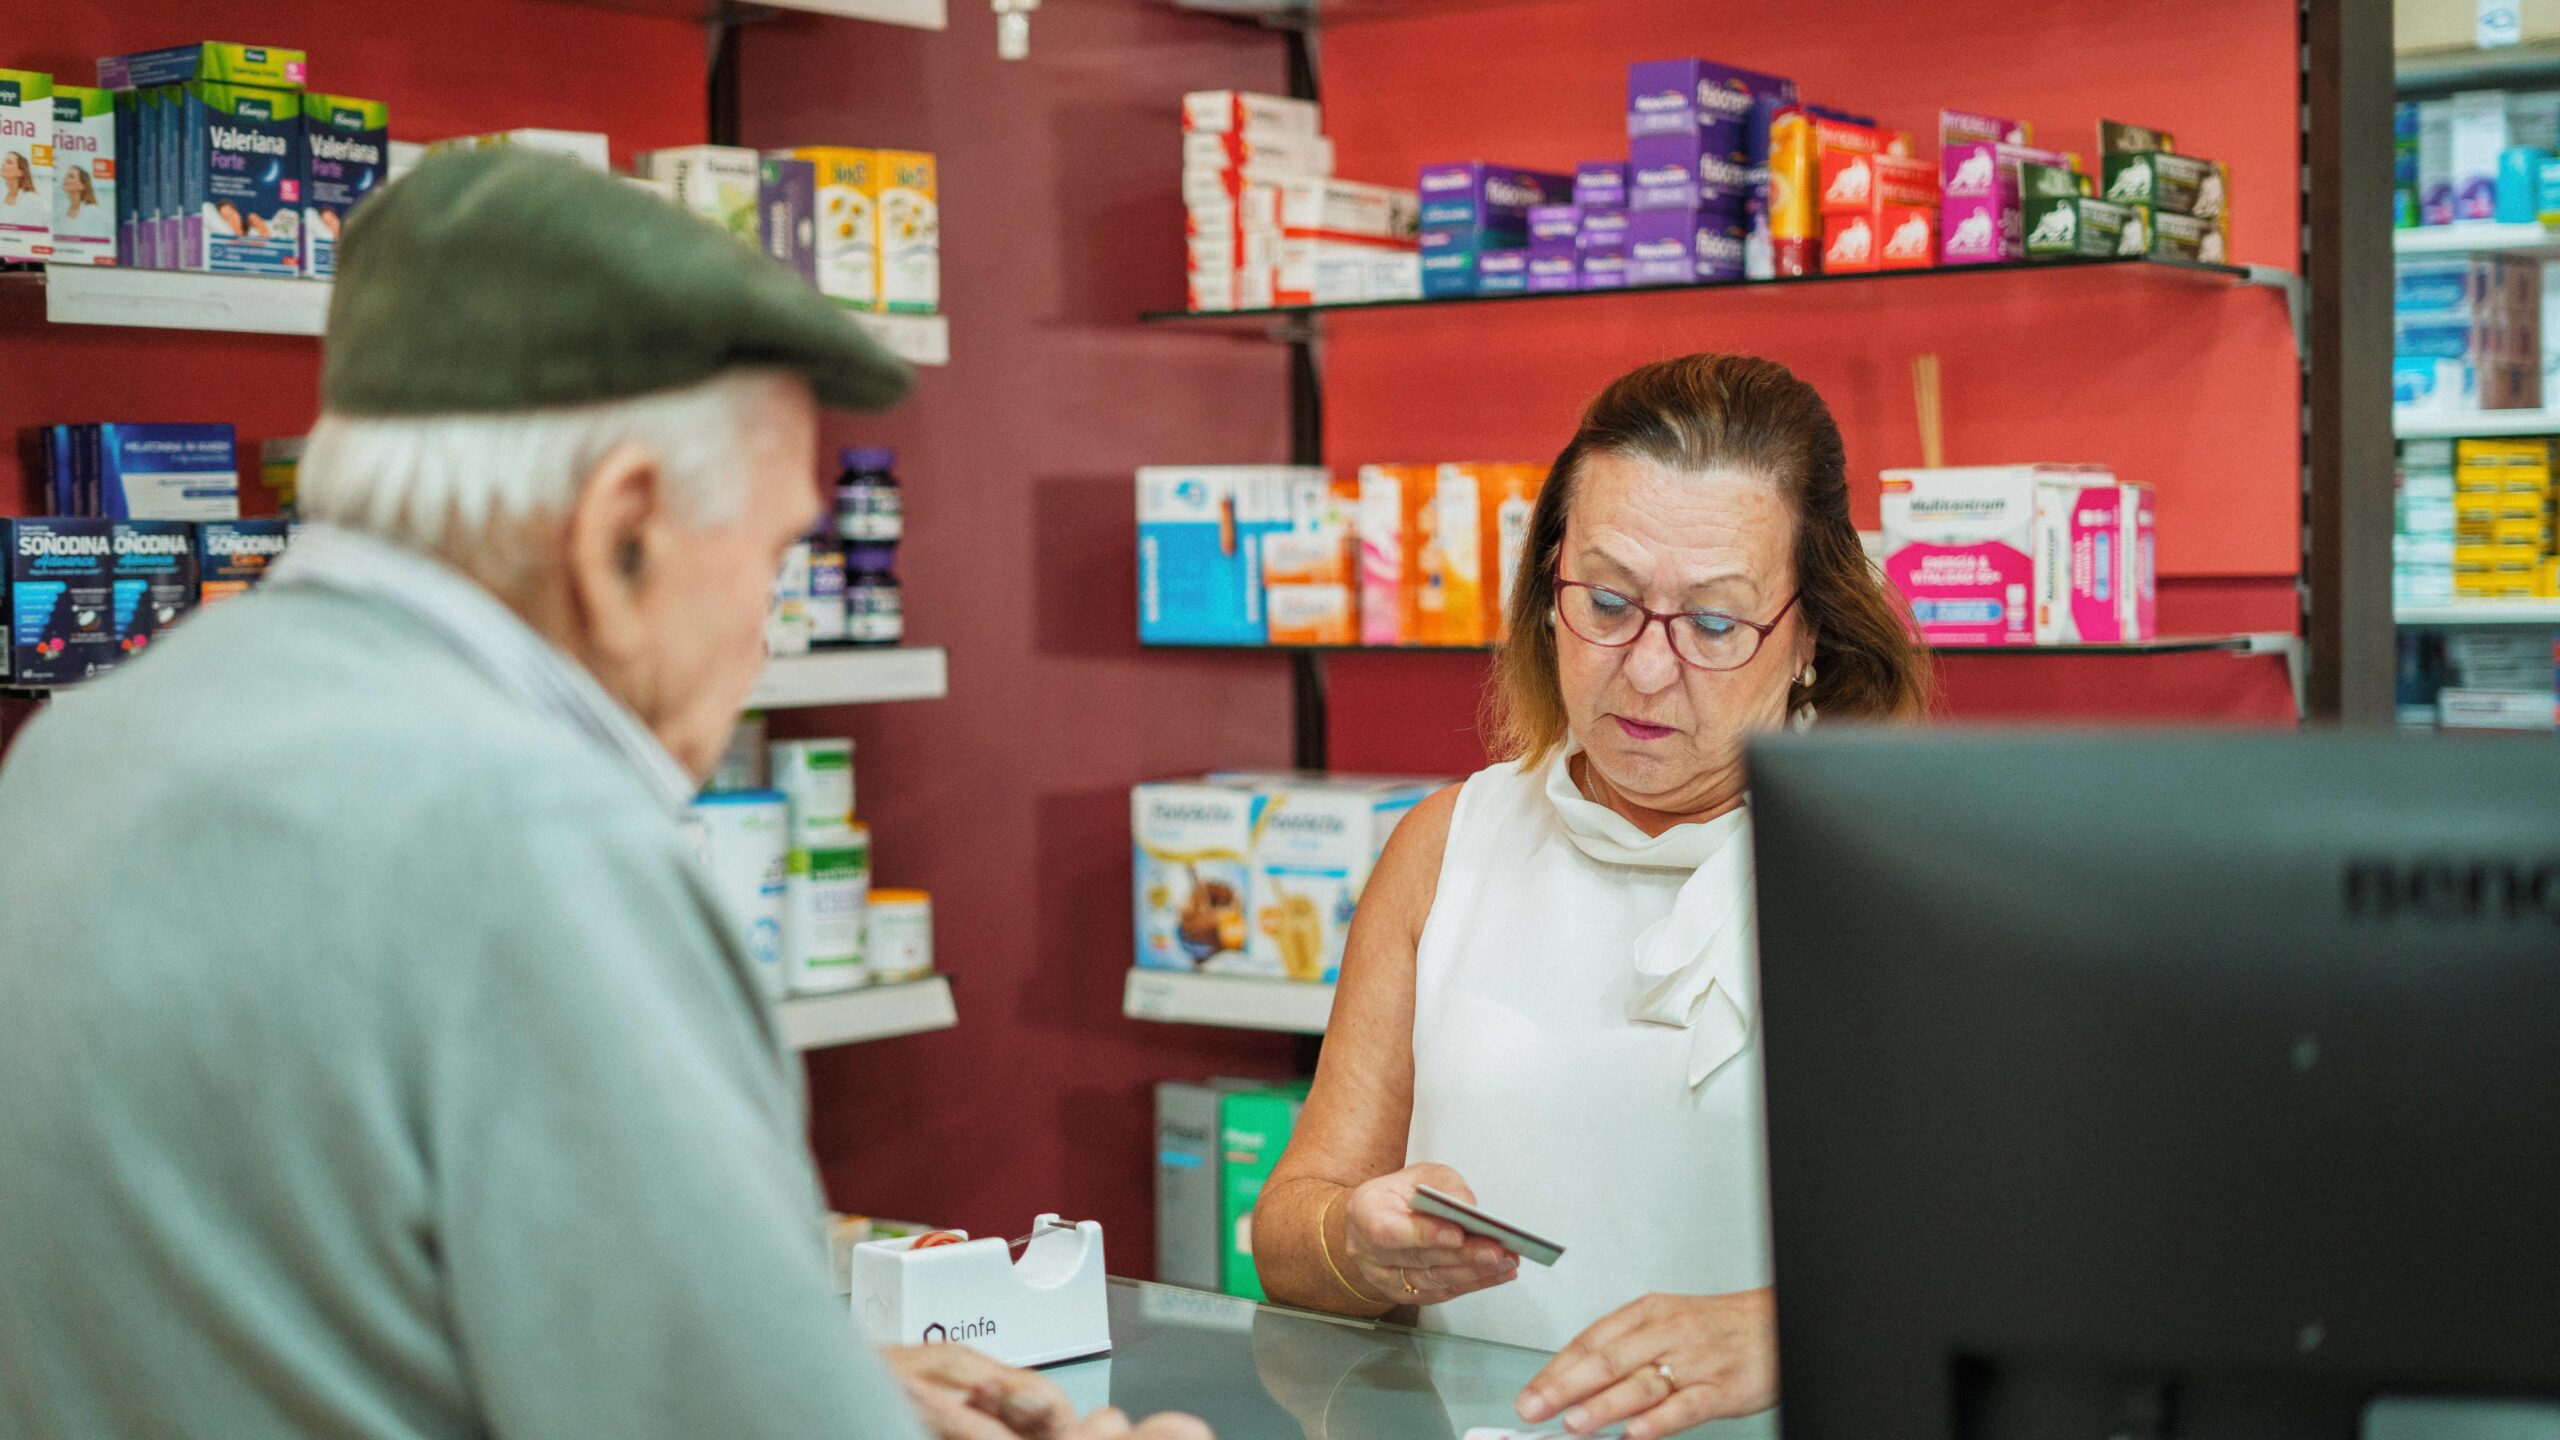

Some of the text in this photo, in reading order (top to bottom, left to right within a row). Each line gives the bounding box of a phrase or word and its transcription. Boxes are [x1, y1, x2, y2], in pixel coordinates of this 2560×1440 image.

[210, 125, 287, 156] Valeriana
[309, 133, 379, 165] Valeriana
[211, 151, 246, 171] Forte
[18, 531, 110, 556] SOÑODINA
